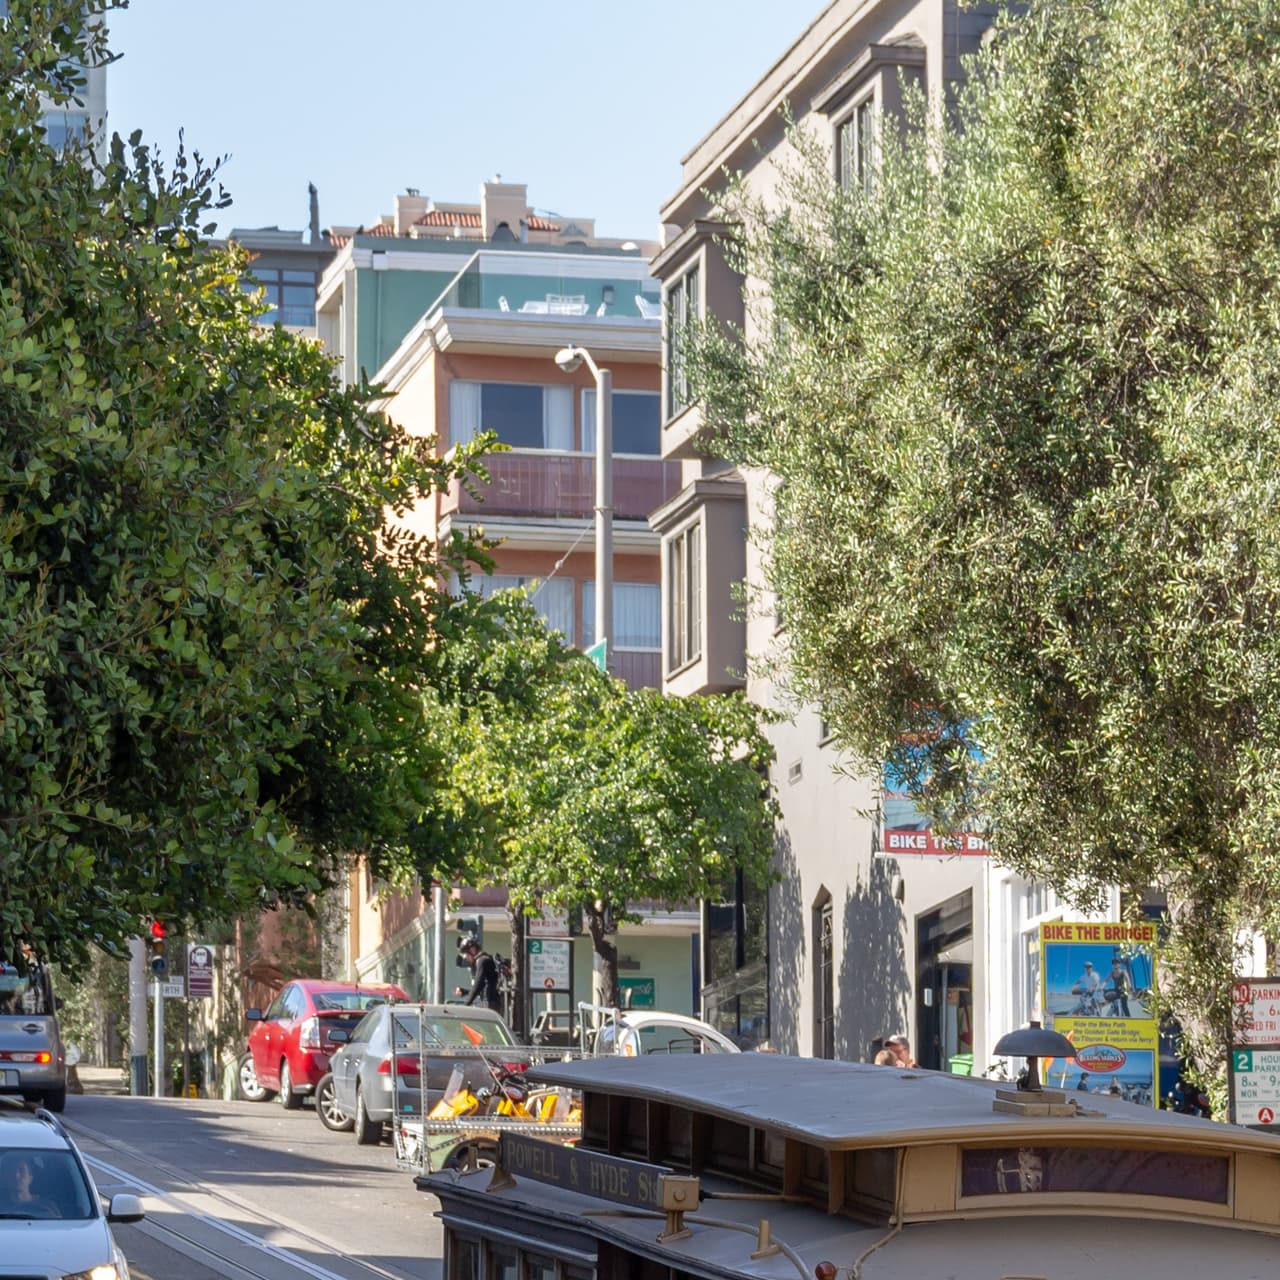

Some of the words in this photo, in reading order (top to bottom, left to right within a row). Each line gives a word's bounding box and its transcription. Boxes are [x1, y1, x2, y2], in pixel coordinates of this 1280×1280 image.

[889, 835, 927, 849] BIKE
[1043, 925, 1073, 939] BIKE
[1076, 925, 1101, 940] THE
[532, 942, 540, 952] 2
[1238, 1054, 1249, 1070] 2
[1241, 1089, 1258, 1098] MON
[1260, 1108, 1272, 1121] A
[507, 1140, 560, 1180] POWELL
[570, 1157, 580, 1186] &
[590, 1161, 630, 1197] HYDE
